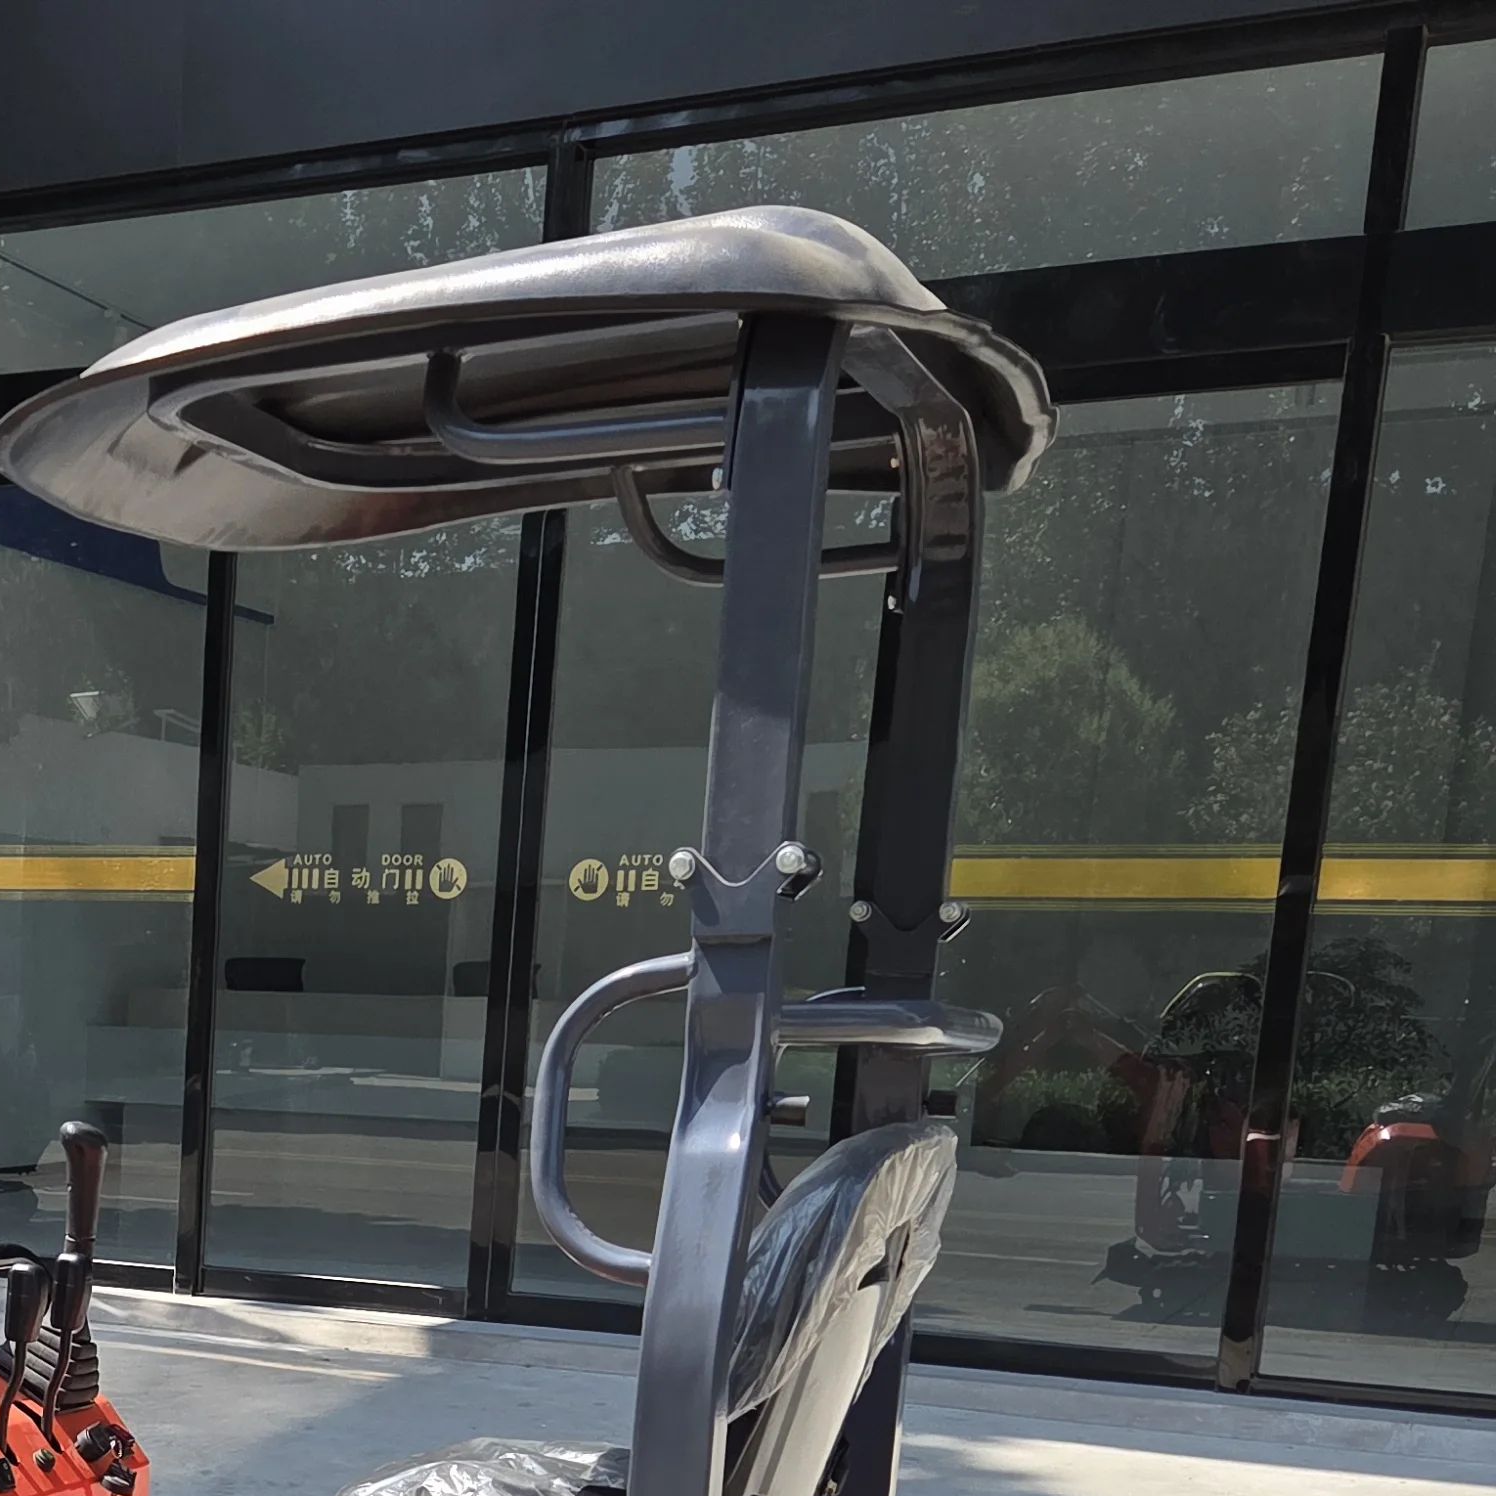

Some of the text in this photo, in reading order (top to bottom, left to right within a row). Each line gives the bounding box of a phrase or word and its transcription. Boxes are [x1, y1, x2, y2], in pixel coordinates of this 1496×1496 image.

[293, 854, 423, 866] AUTO DOOR
[619, 854, 663, 866] AUTO
[324, 867, 400, 889] 自动门
